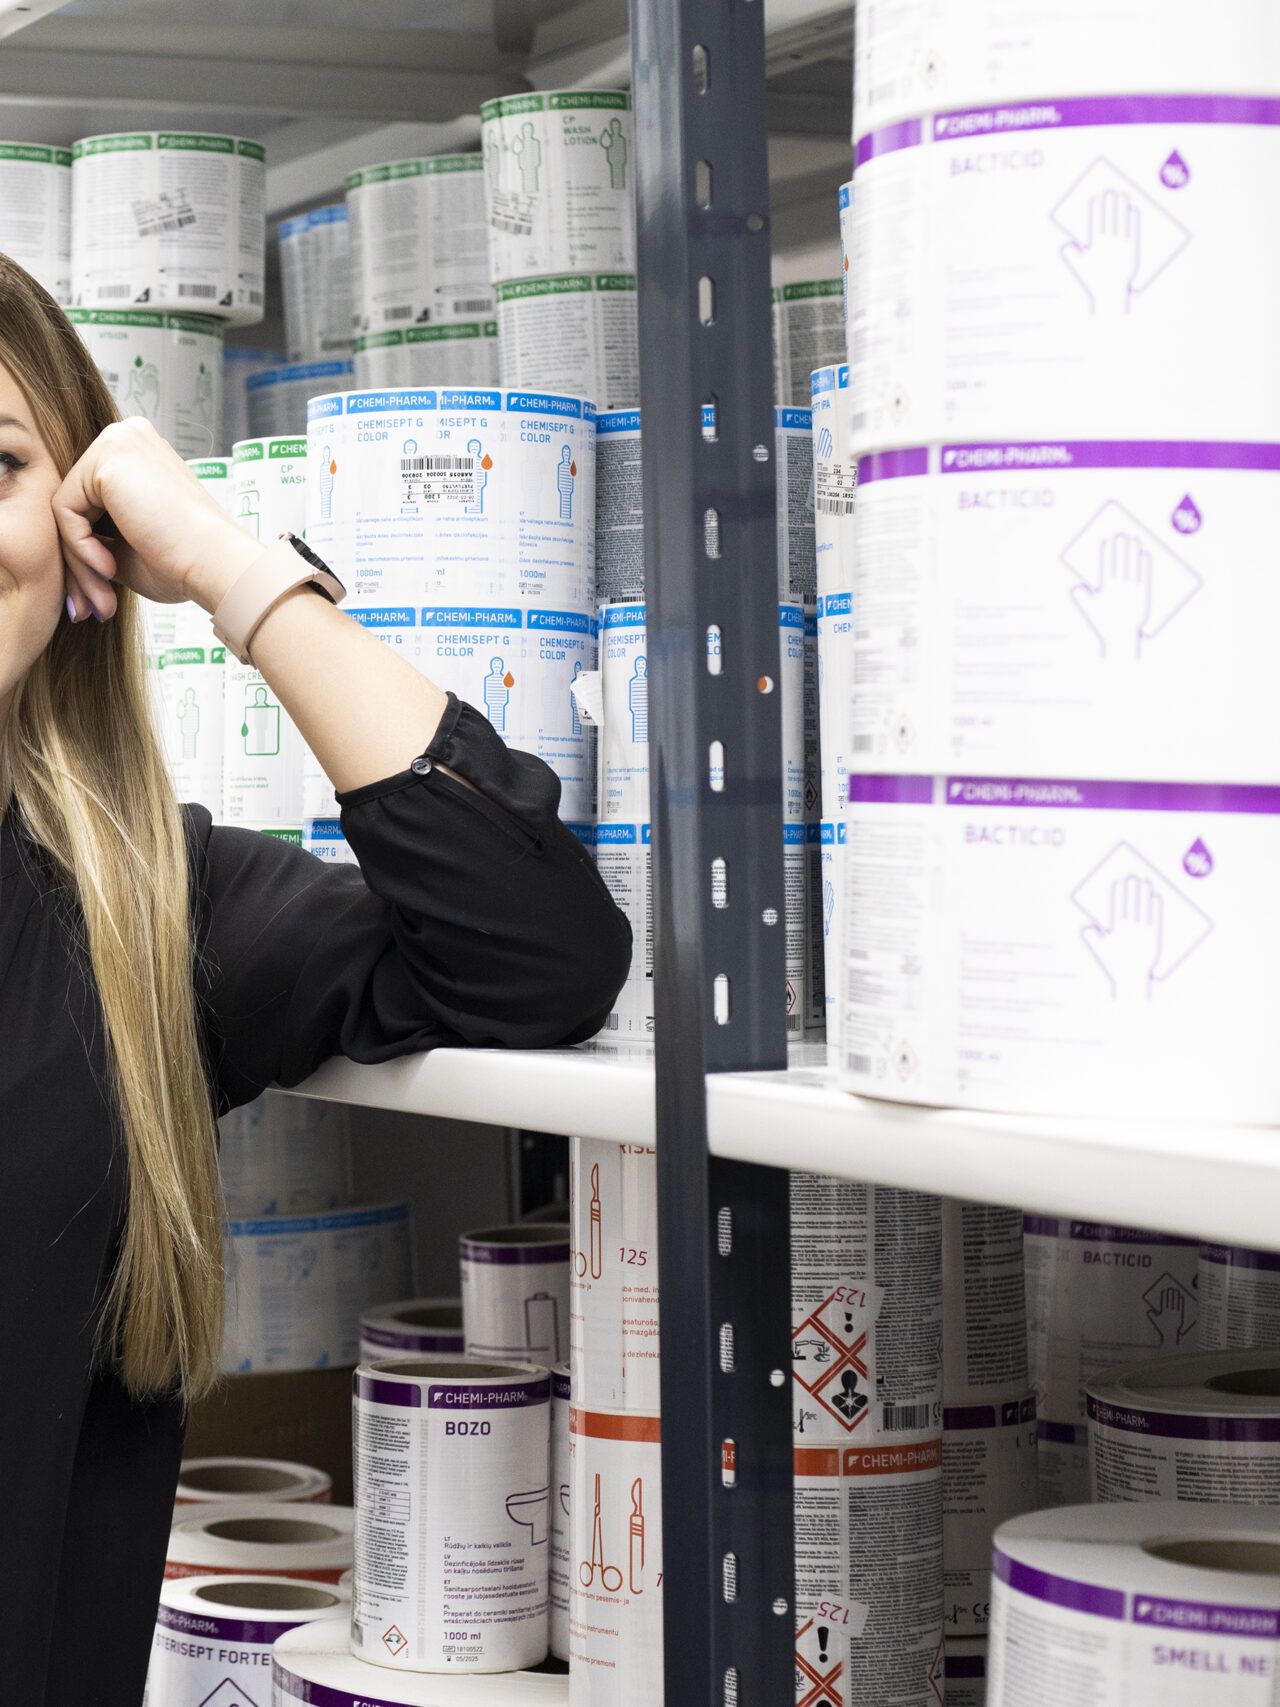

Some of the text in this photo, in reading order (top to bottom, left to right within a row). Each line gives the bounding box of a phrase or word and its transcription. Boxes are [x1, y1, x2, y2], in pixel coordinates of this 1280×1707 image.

[563, 126, 591, 134] WASH
[563, 136, 598, 145] LOTION
[950, 150, 1045, 176] BACTICID
[357, 395, 428, 408] CHEMI-PHARM
[520, 398, 578, 412] CHEMI-PHARM
[357, 418, 424, 430] CHEMISEPT G
[480, 417, 488, 427] G
[520, 419, 575, 434] CHEMISEPT G
[357, 431, 389, 442] COLOR
[520, 432, 551, 443] COLOR
[280, 464, 293, 473] CP
[958, 489, 1056, 510] BACTICID
[356, 569, 383, 577] 1000ml
[520, 570, 546, 579] 1000ml
[436, 612, 514, 623] CHEMI-PHARM
[539, 615, 587, 629] CHEMI-PHARM
[395, 635, 403, 644] G
[436, 635, 510, 645] CHEMISEPT G
[539, 637, 585, 650] CHEMISEPT G
[436, 647, 474, 657] COLOR
[539, 650, 566, 660] COLOR
[964, 824, 1066, 846] BACTICID
[619, 1247, 648, 1267] 125
[1083, 1250, 1152, 1268] BACTICID
[833, 1286, 866, 1308] 125
[445, 1391, 526, 1404] CHEMI-PHARM
[1096, 1405, 1146, 1427] CHEMI-PHARM
[445, 1421, 491, 1436] BOZO
[862, 1448, 937, 1469] CHEMI-PHARM
[444, 1592, 465, 1600] rooste
[466, 1592, 473, 1600] ja
[817, 1600, 850, 1625] 125
[1153, 1605, 1277, 1633] CHEMI-PHARM
[444, 1631, 481, 1641] 1000 ml
[156, 1633, 270, 1666] STERISEPT FORTE
[1152, 1643, 1230, 1674] SMELL
